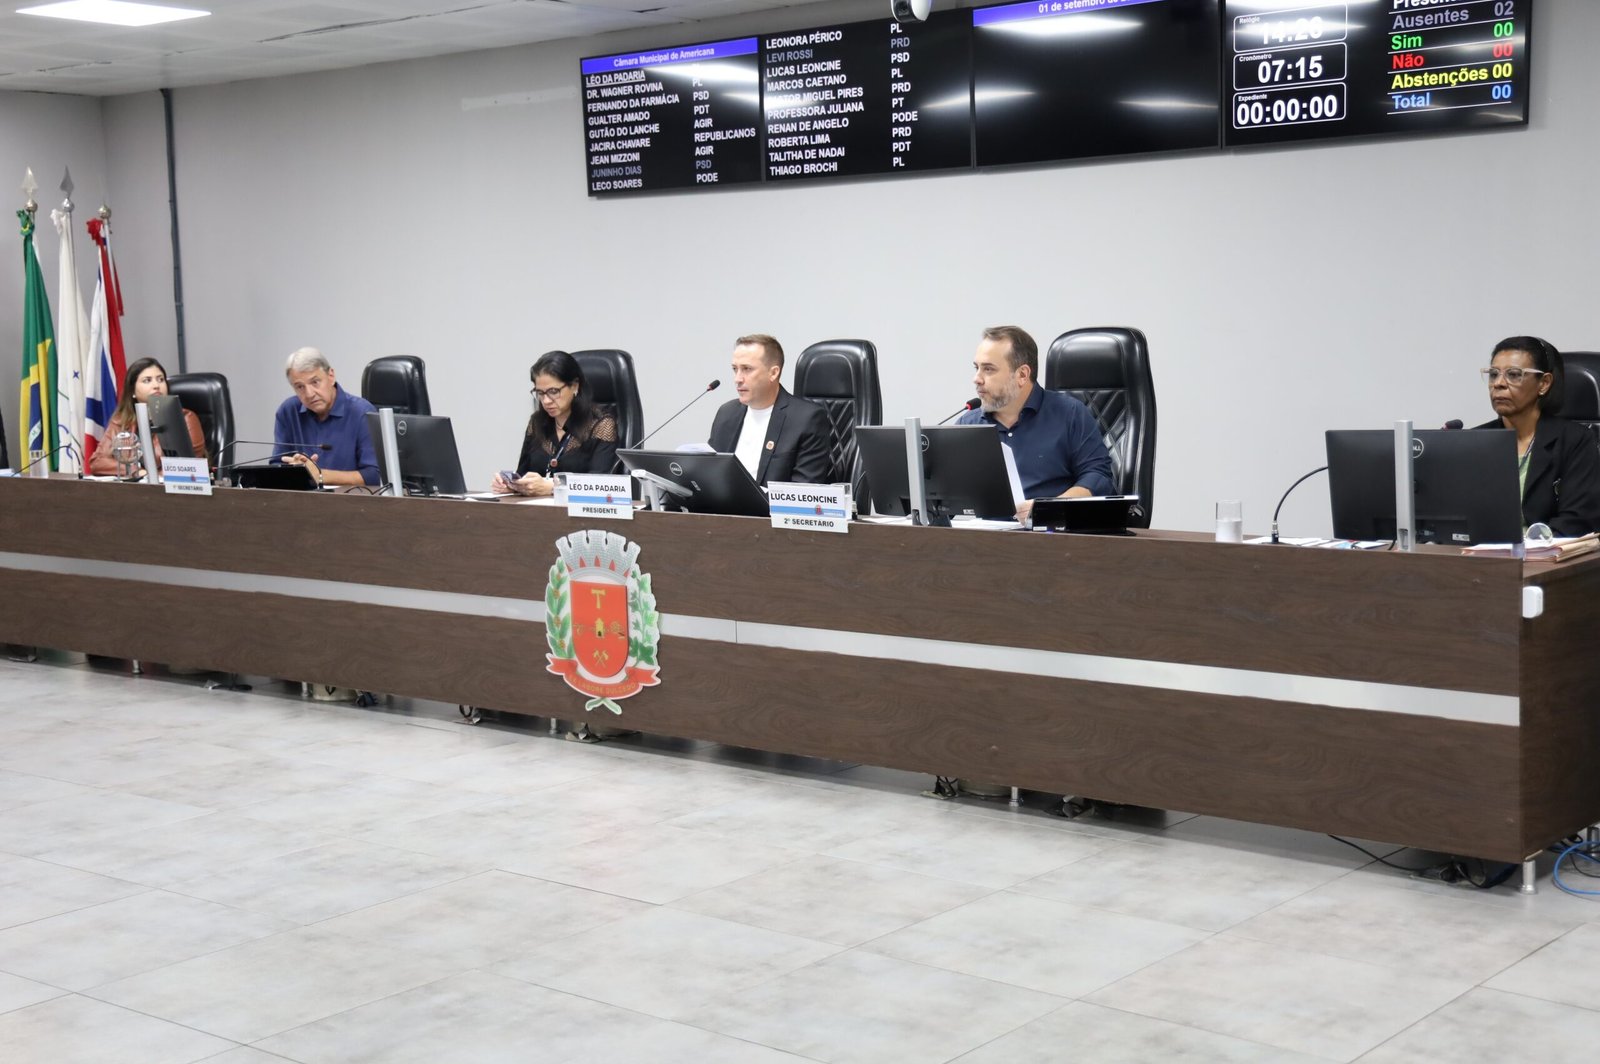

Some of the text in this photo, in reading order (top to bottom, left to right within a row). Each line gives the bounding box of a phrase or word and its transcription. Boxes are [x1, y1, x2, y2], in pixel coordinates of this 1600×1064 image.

[1038, 4, 1048, 13] 01
[1051, 2, 1062, 12] de
[1064, 0, 1104, 9] setembro
[1393, 1, 1514, 29] Ausentes 02
[766, 23, 902, 49] LEONORA PÉRICO PL
[1392, 22, 1513, 50] Sim 00
[614, 47, 715, 67] Câmara Municipal de Americana
[767, 37, 910, 63] LEVI ROSSI PRD
[1239, 53, 1272, 62] Cronômetro
[1393, 43, 1513, 69] Não 00
[767, 52, 910, 78] LUCAS LEONCINE PSD
[1258, 55, 1322, 83] 07:15
[586, 70, 645, 85] LÉO DA PADARIA
[767, 68, 903, 92] MARCOS CAETANO PL
[1391, 63, 1512, 89] Abstenções 00
[587, 88, 599, 99] DR.
[600, 84, 634, 97] WAGNER
[634, 82, 664, 94] ROVINA
[802, 89, 836, 102] MIGUEL
[838, 87, 863, 99] PIRES
[892, 82, 911, 93] PRD
[1238, 94, 1267, 102] Expediente
[1392, 85, 1511, 109] Total 00
[588, 91, 709, 112] FERNANDO DA FARMÁCIA PSD
[768, 98, 904, 120] PROFESSORA JULIANA PT
[1237, 95, 1338, 125] 00:00:00
[589, 105, 710, 126] GUALTER AMADO PDT
[768, 111, 918, 134] RENAN DE ANGELO PODE
[589, 118, 713, 139] GUTÃO DO LANCHE AGIR
[768, 127, 912, 148] ROBERTA LIMA PRD
[590, 128, 756, 152] JACIRA CHAVARE REPUBLICANOS
[591, 146, 714, 165] JEAN MIZZONI AGIR
[769, 141, 912, 162] TALITHA DE NADAI PDT
[592, 160, 712, 178] JUNINHO DIAS PSD
[770, 157, 905, 176] THIAGO BROCHI PL
[592, 172, 718, 191] LECO SOARES PODE
[569, 482, 582, 490] LÉO
[771, 493, 838, 504] LUCAS LEONCINE
[792, 518, 834, 527] SECRETÁRIO
